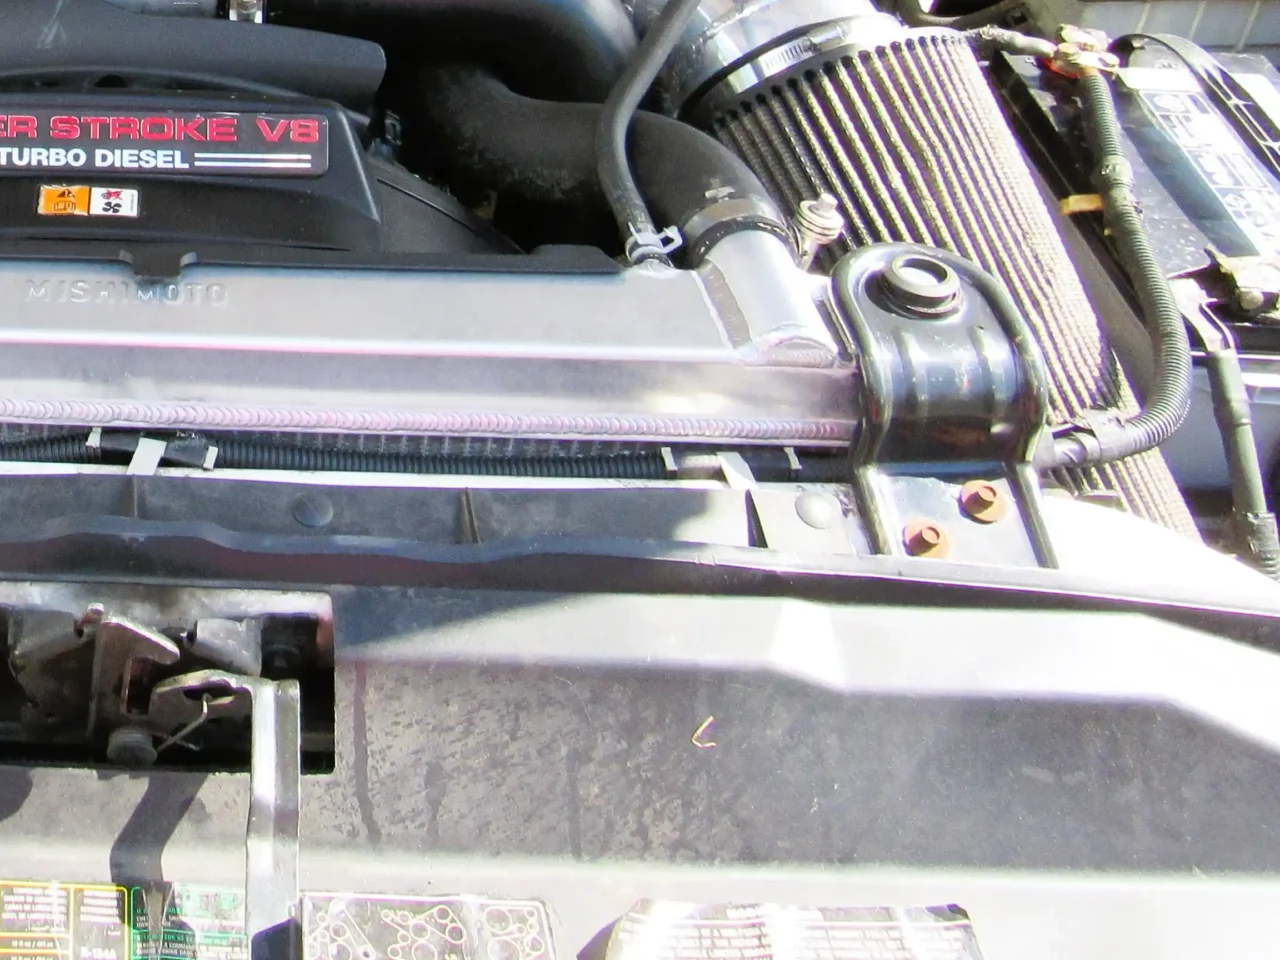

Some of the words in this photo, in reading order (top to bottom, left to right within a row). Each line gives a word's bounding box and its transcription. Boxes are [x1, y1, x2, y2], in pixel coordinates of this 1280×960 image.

[50, 115, 237, 142] STROKE
[255, 117, 319, 143] V8
[95, 149, 189, 169] DIESEL
[25, 279, 229, 306] MISHIMOTO
